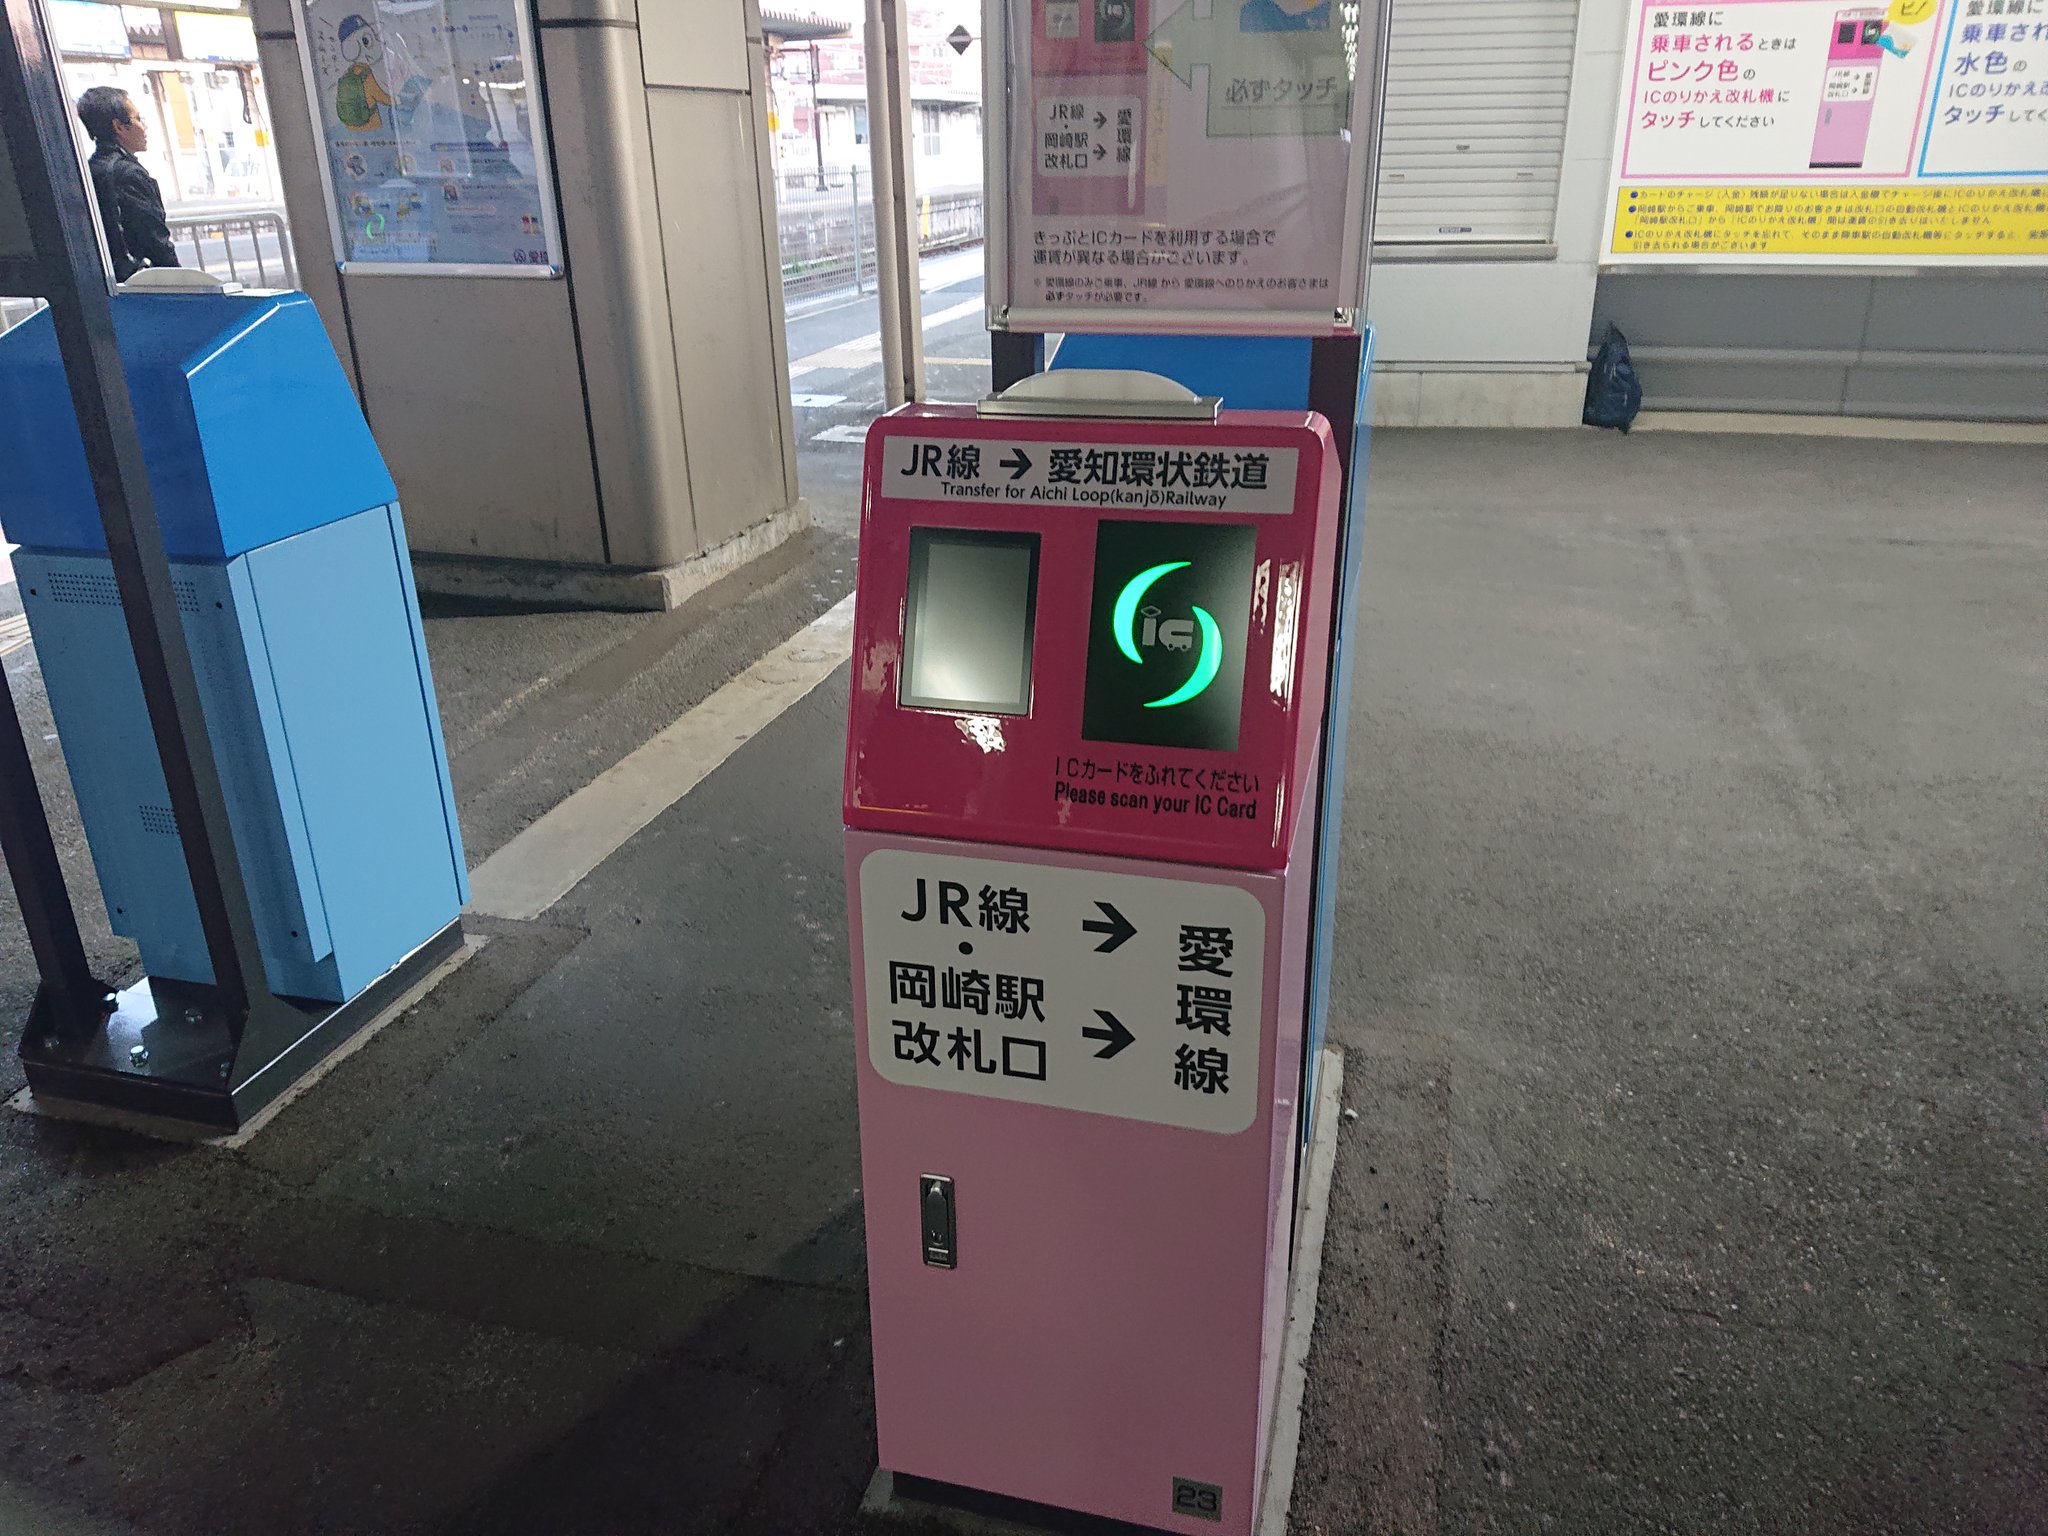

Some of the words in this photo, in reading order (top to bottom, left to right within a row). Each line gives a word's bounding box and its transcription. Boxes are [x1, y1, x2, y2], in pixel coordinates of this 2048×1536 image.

[1653, 11, 1724, 28] 愛環線に
[1650, 32, 1797, 54] 乗車されるときは
[1648, 58, 1756, 83] ピンク色の
[1953, 50, 2028, 77] 水色の
[1225, 76, 1338, 104] 必ずタッチ
[1643, 88, 1791, 105] ICのりかえ改札機に
[1049, 104, 1085, 121] JR線
[1641, 110, 1775, 130] タッチしてください
[1044, 131, 1089, 149] 岡崎駅
[1115, 107, 1133, 164] 愛環線
[1044, 152, 1089, 170] 改札口
[1032, 229, 1277, 247] きっぷとICカードを利用する場合で
[1032, 248, 1250, 266] 運賃が異なる場合がございます。
[900, 442, 982, 480] JR線
[1047, 447, 1270, 491] 愛知環状鉄道
[941, 481, 1000, 499] Transfer
[1005, 484, 1026, 500] for
[1030, 484, 1068, 502] Aichi
[1055, 756, 1259, 794] ICカードをふれてください
[1055, 780, 1106, 804] Please
[1109, 787, 1150, 807] scan
[1153, 794, 1192, 814] your
[1194, 792, 1214, 814] IC
[1216, 793, 1258, 819] Card
[900, 877, 1031, 935] JR線
[889, 960, 1047, 1023] 岡崎駅
[1173, 923, 1235, 1096] 愛環線
[891, 1018, 1048, 1082] 改札口
